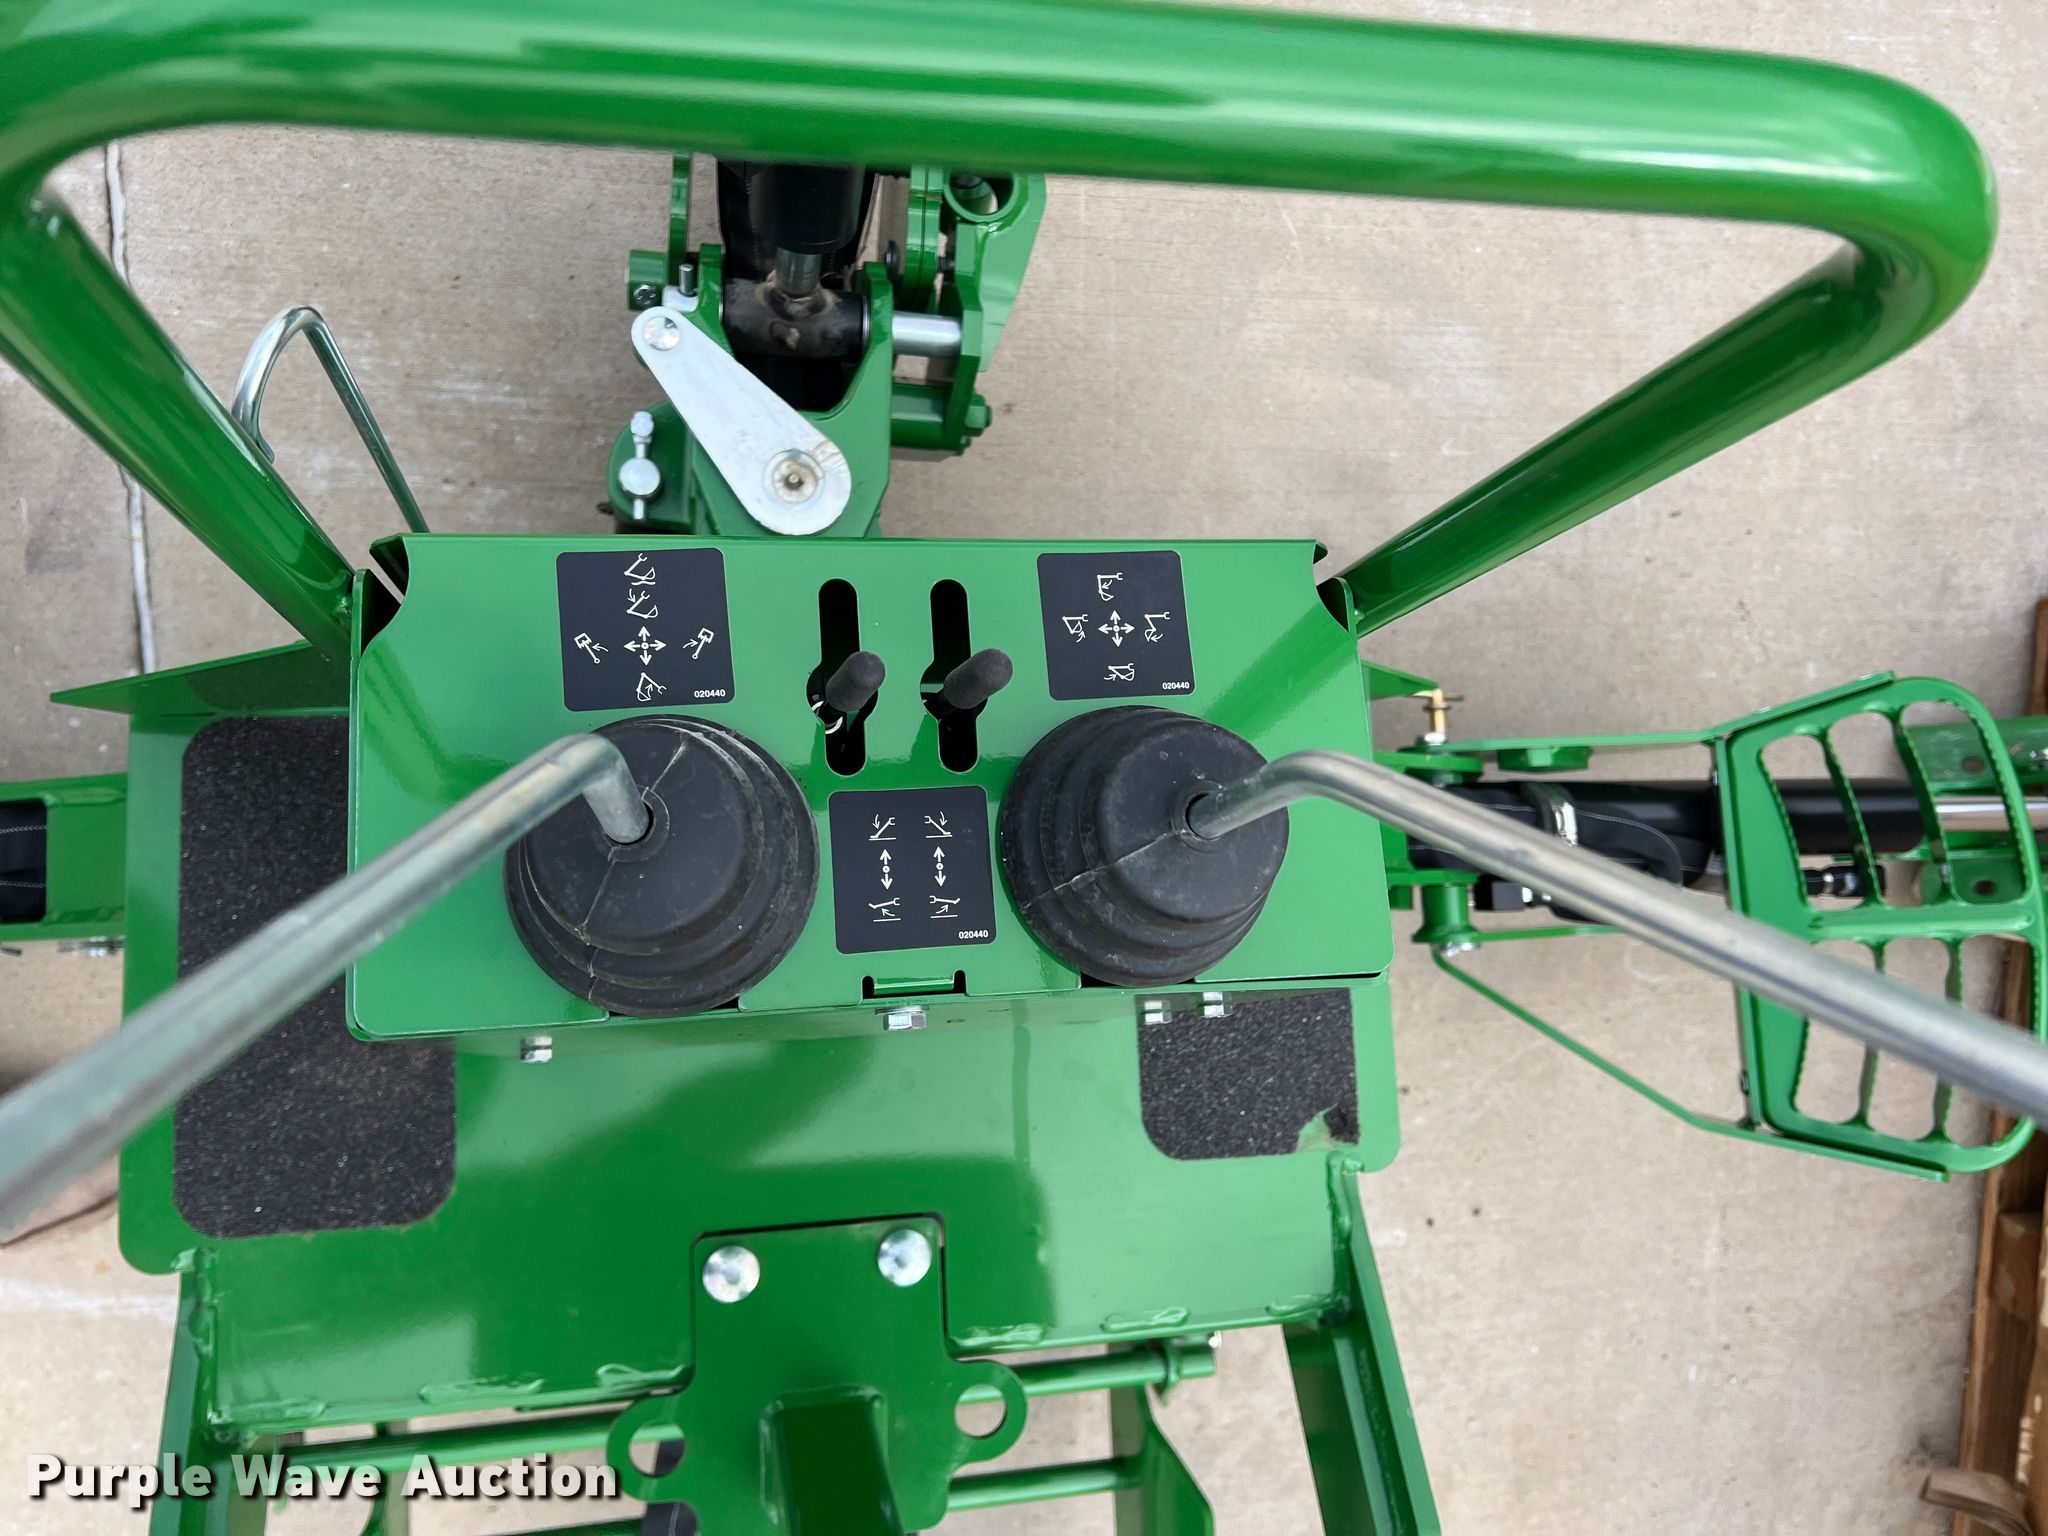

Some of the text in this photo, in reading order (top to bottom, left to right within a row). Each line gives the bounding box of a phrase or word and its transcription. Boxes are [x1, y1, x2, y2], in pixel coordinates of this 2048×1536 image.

[1162, 681, 1190, 690] 020440
[693, 689, 726, 698] 020440
[958, 930, 989, 939] 020440
